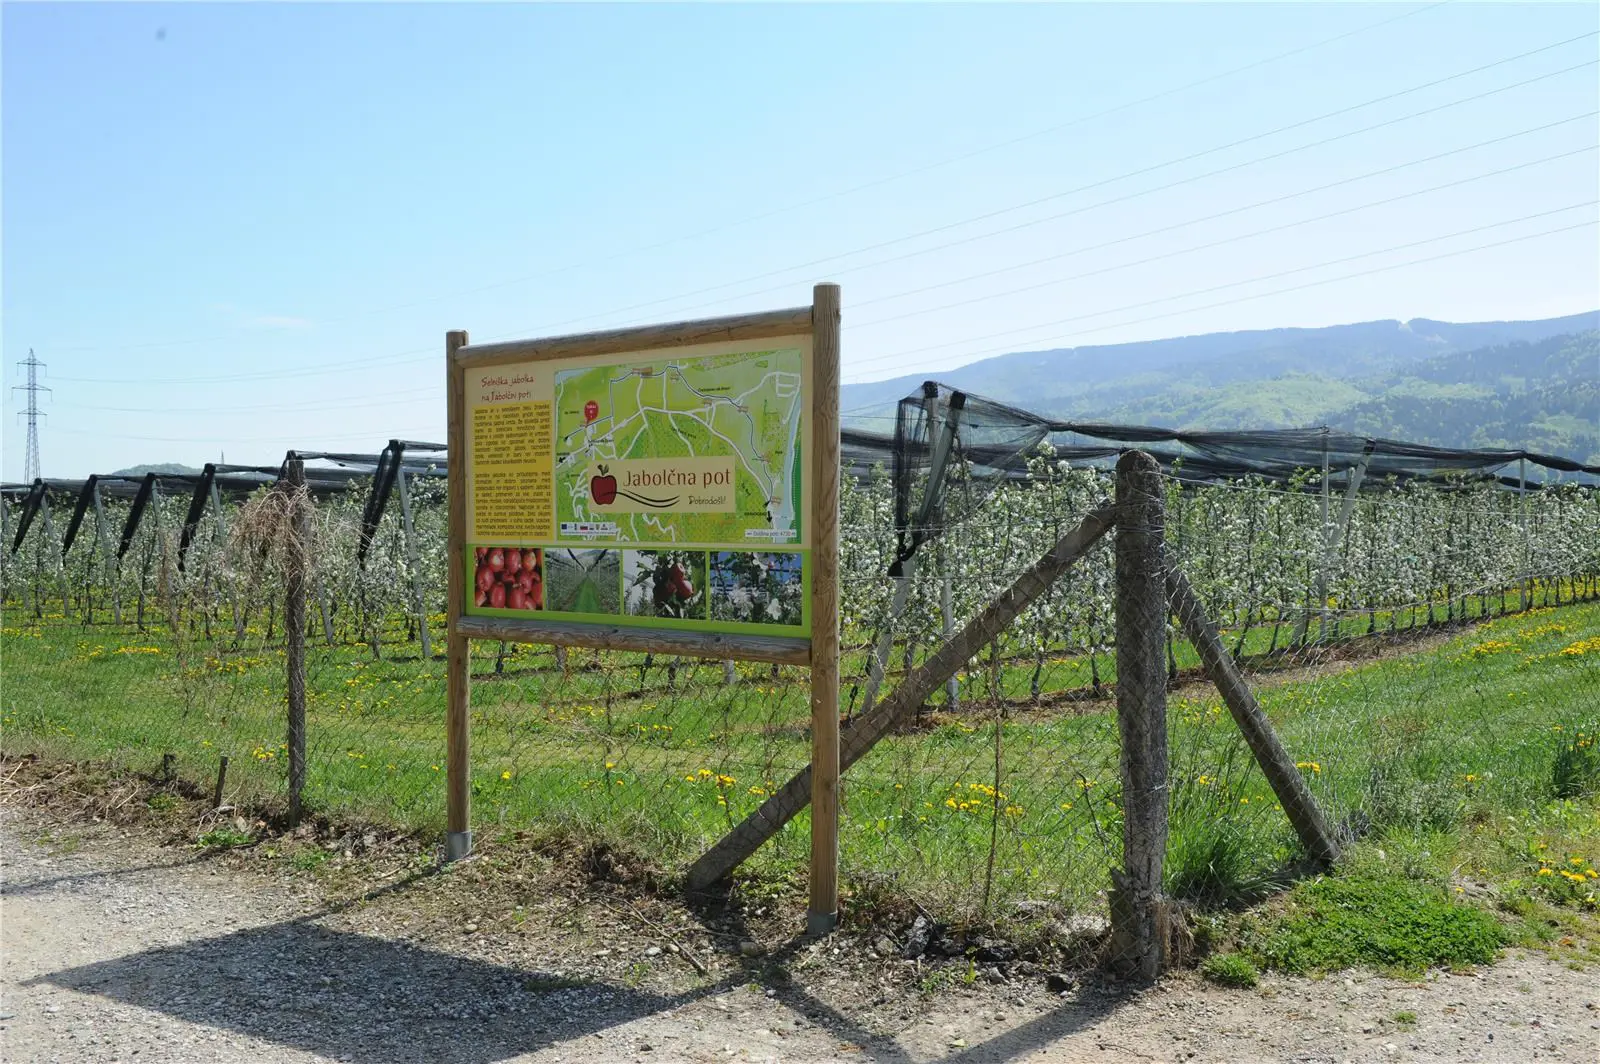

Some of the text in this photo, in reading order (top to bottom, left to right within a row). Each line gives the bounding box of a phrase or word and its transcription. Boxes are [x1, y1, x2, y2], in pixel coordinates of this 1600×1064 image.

[509, 374, 534, 387] jabolka
[481, 394, 489, 402] na
[518, 390, 531, 400] poti
[622, 469, 696, 487] Jabolčna
[703, 468, 731, 489] pot
[688, 495, 727, 505] Dobrodošli!
